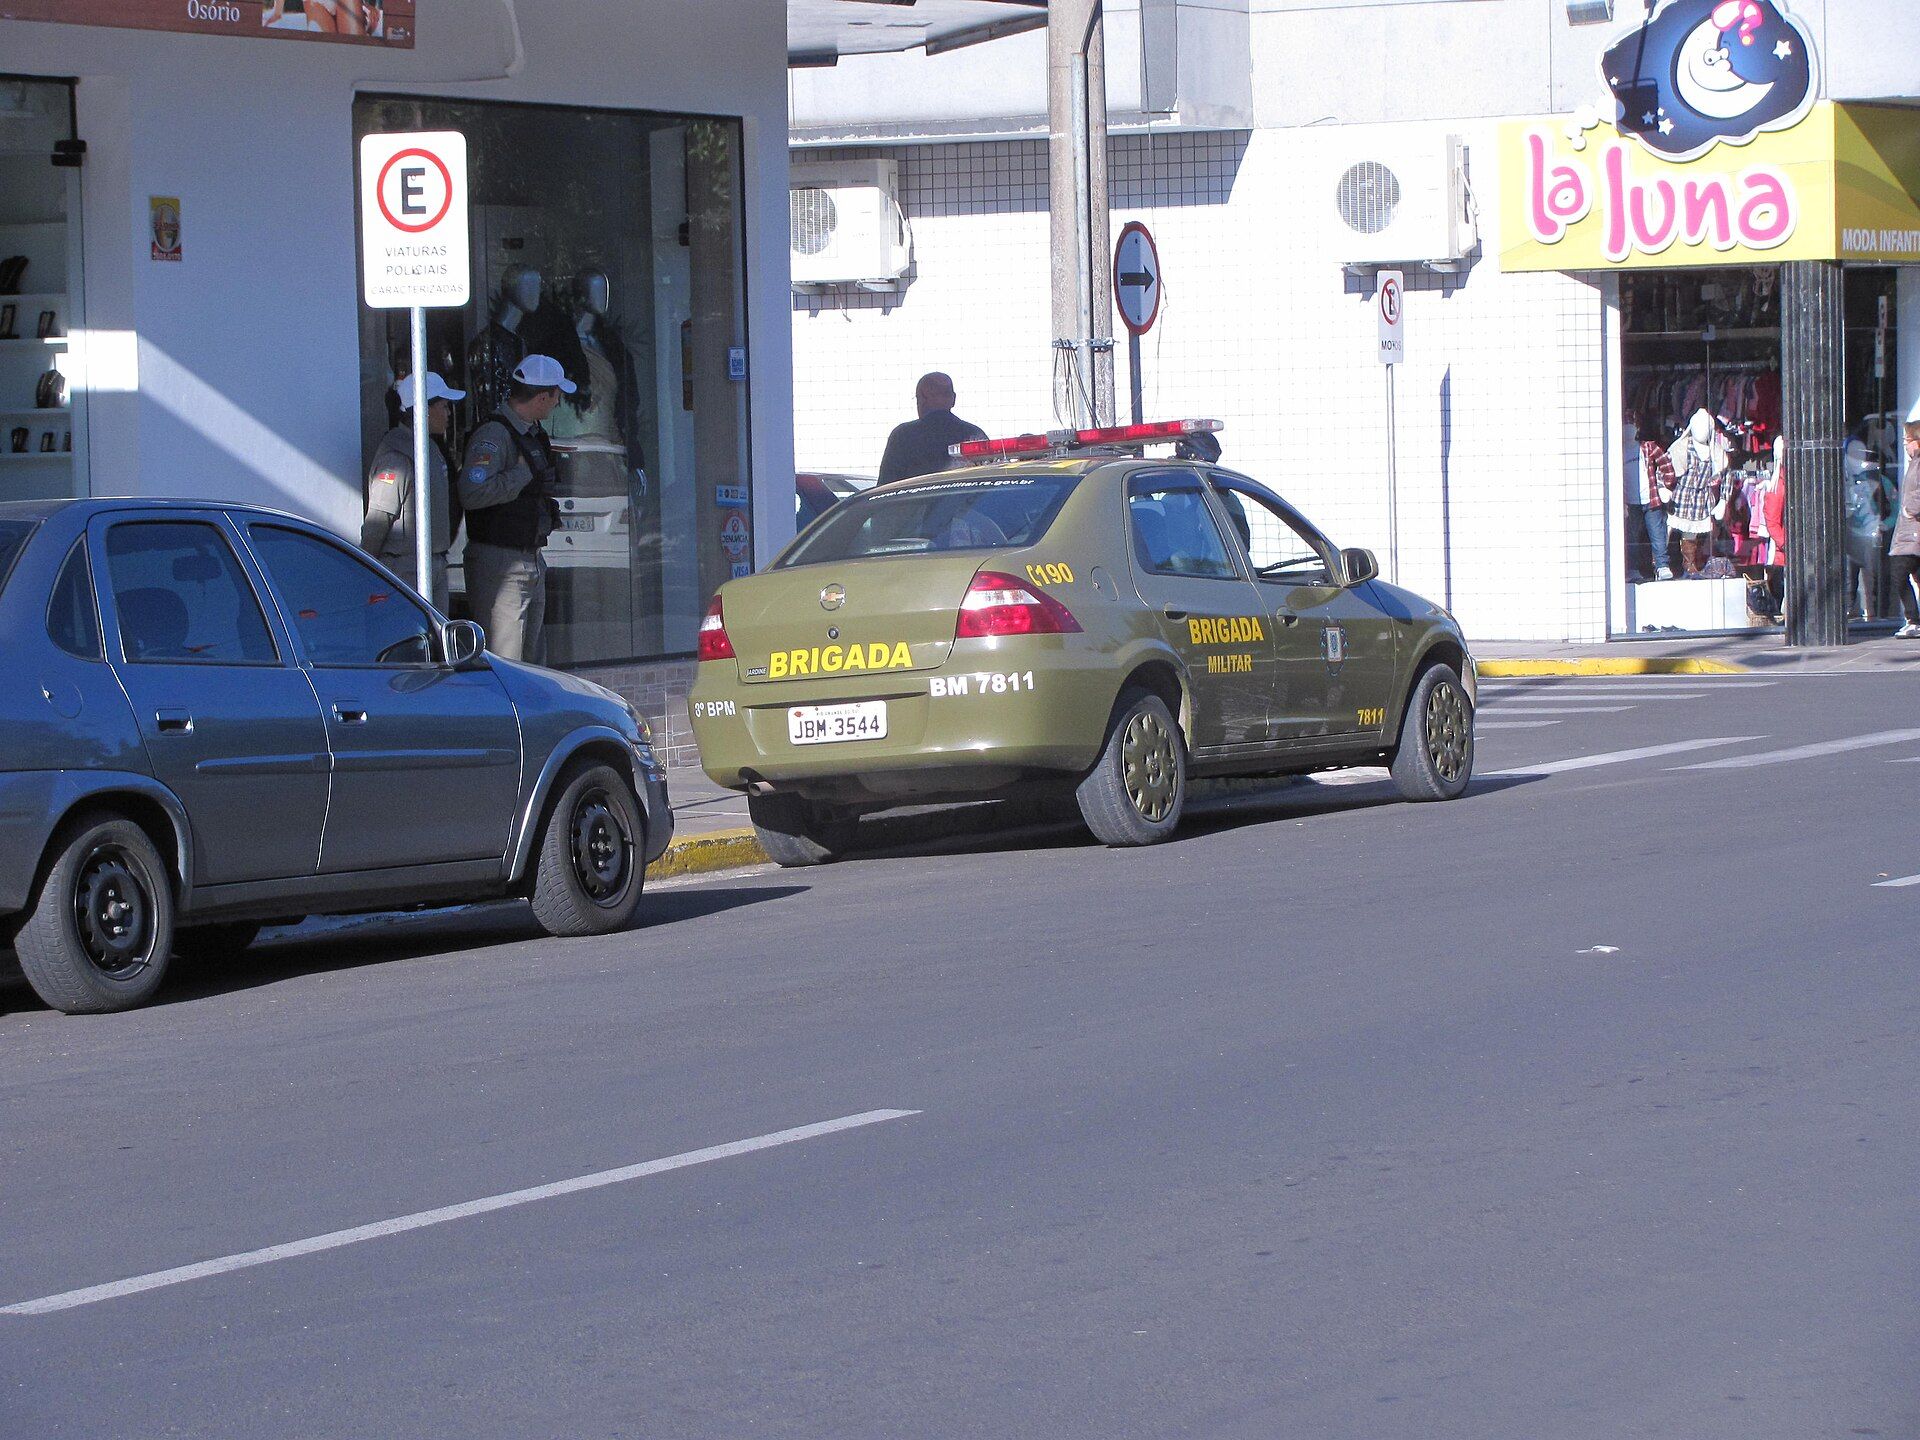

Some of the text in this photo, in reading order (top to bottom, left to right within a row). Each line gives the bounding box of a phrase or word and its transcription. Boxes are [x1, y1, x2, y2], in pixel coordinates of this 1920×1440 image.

[187, 0, 240, 21] Osório
[400, 167, 427, 215] E
[1529, 134, 1790, 254] la luna
[1842, 228, 1878, 251] MODA
[385, 245, 448, 257] VIATURAS
[386, 263, 448, 276] POLICIAIS
[370, 283, 465, 296] CARACTERIZADAS
[1188, 616, 1264, 644] BRIGADA
[768, 641, 914, 679] BRIGADA
[1207, 654, 1253, 674] MILITAR
[929, 670, 1035, 697] BM 7811
[706, 700, 736, 717] BPM
[1357, 707, 1385, 726] 7811
